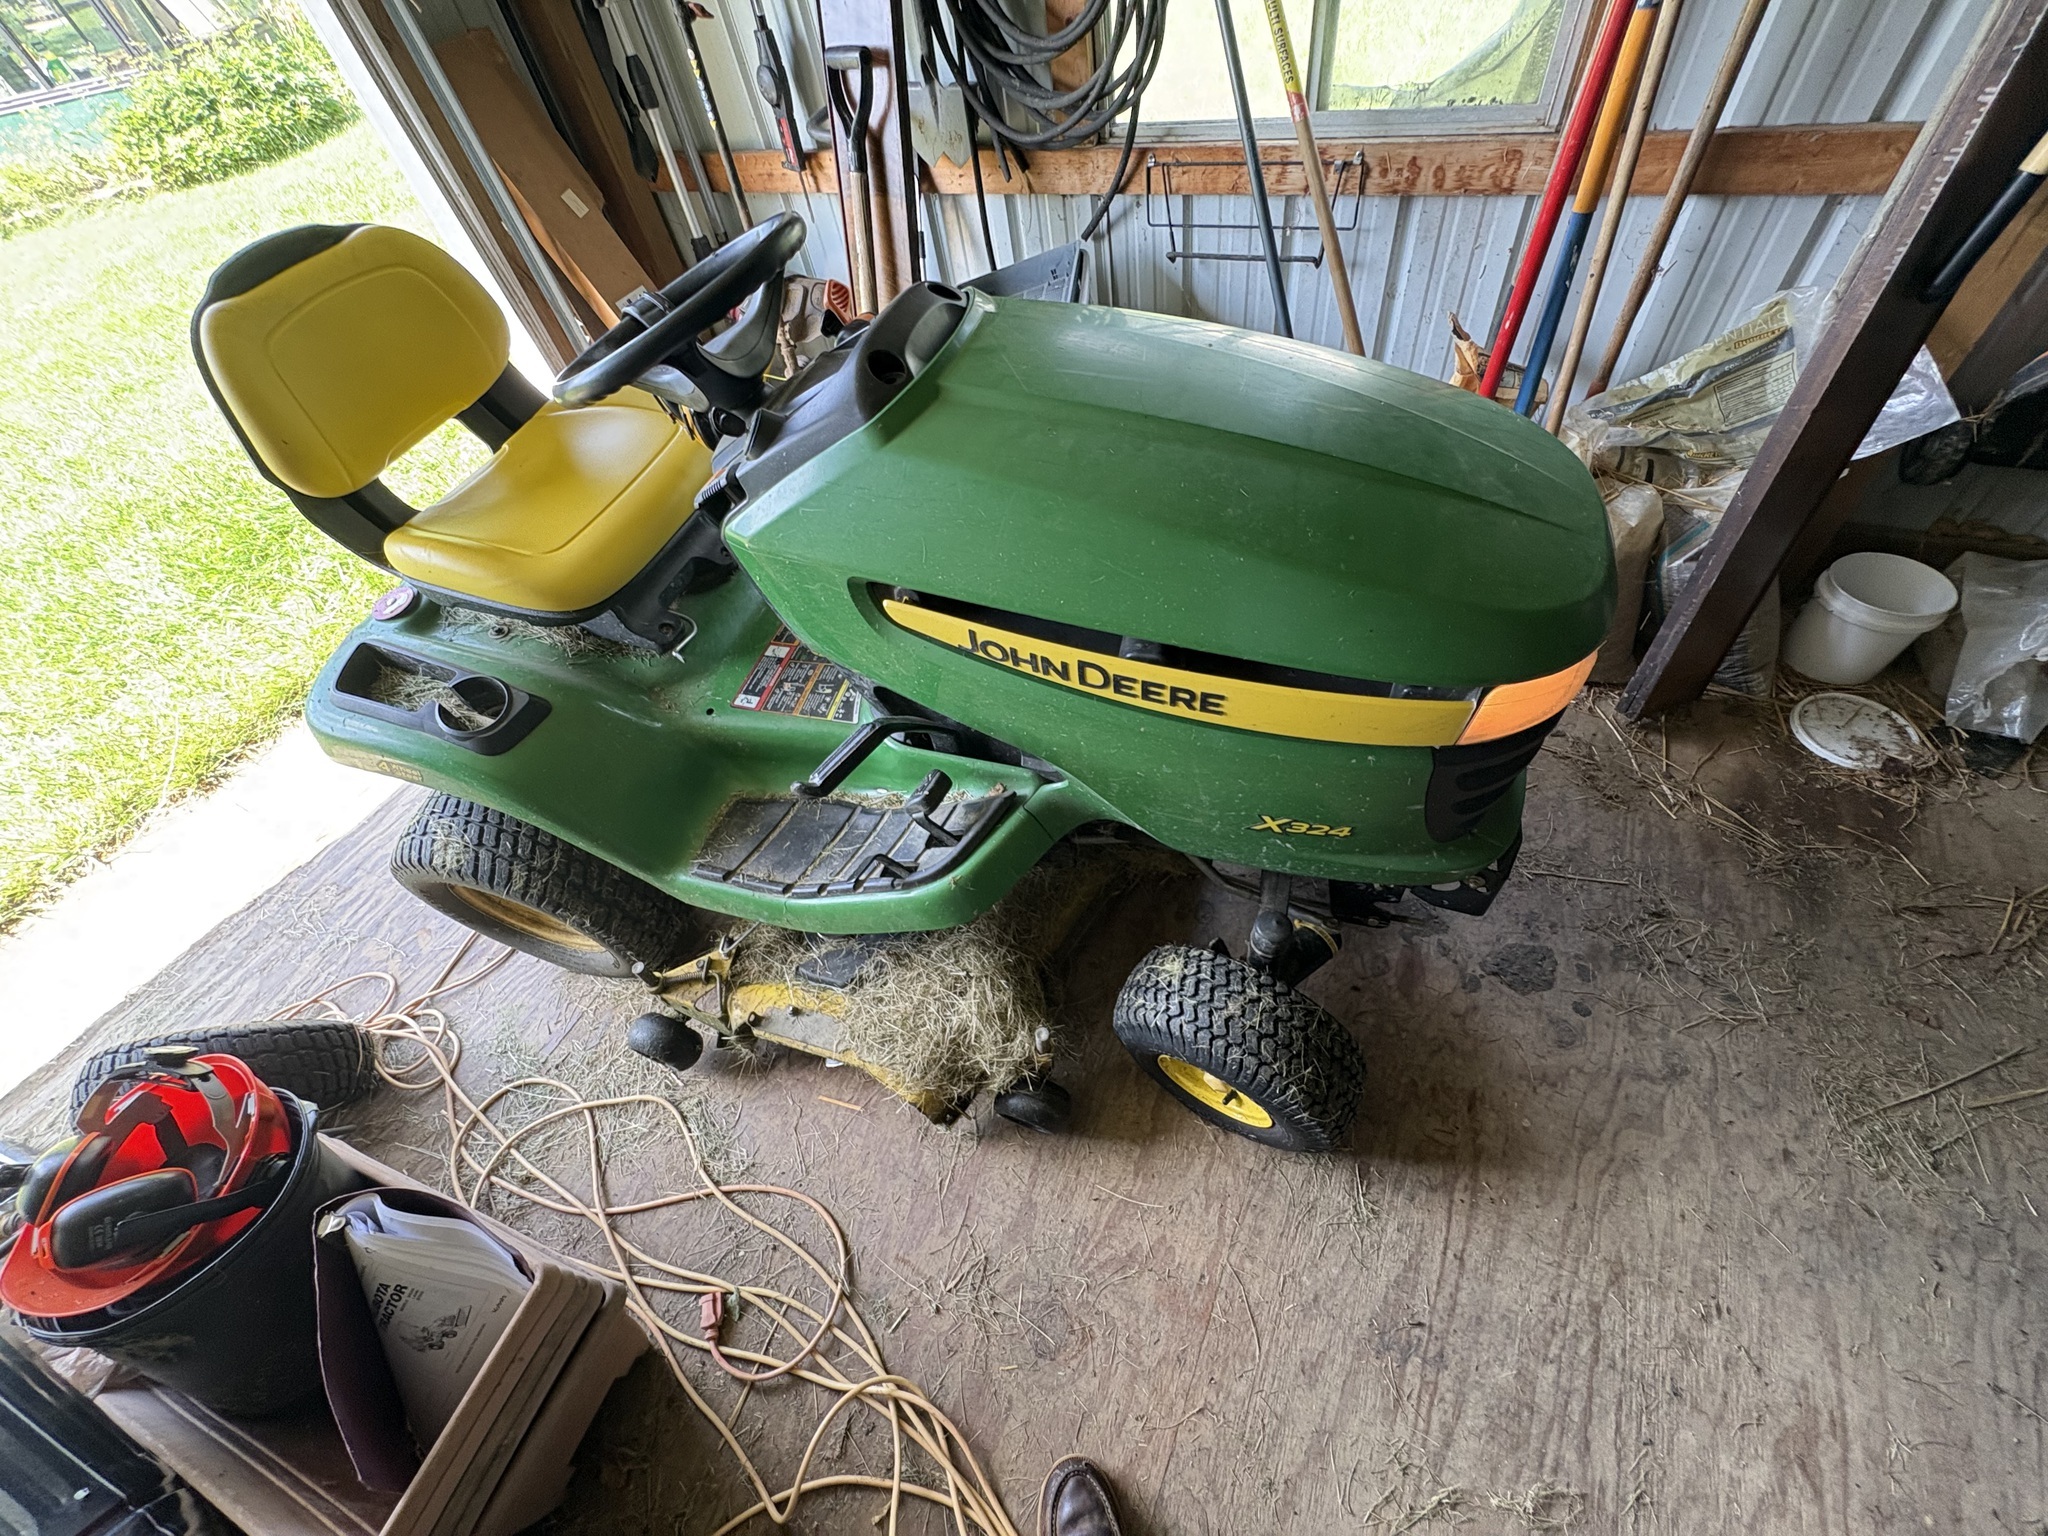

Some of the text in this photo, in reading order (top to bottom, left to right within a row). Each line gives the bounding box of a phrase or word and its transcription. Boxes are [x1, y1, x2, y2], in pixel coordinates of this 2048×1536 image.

[1265, 0, 1294, 84] ULTI SURFACES
[958, 629, 1227, 717] JOHN DEERE
[1246, 814, 1353, 838] X324
